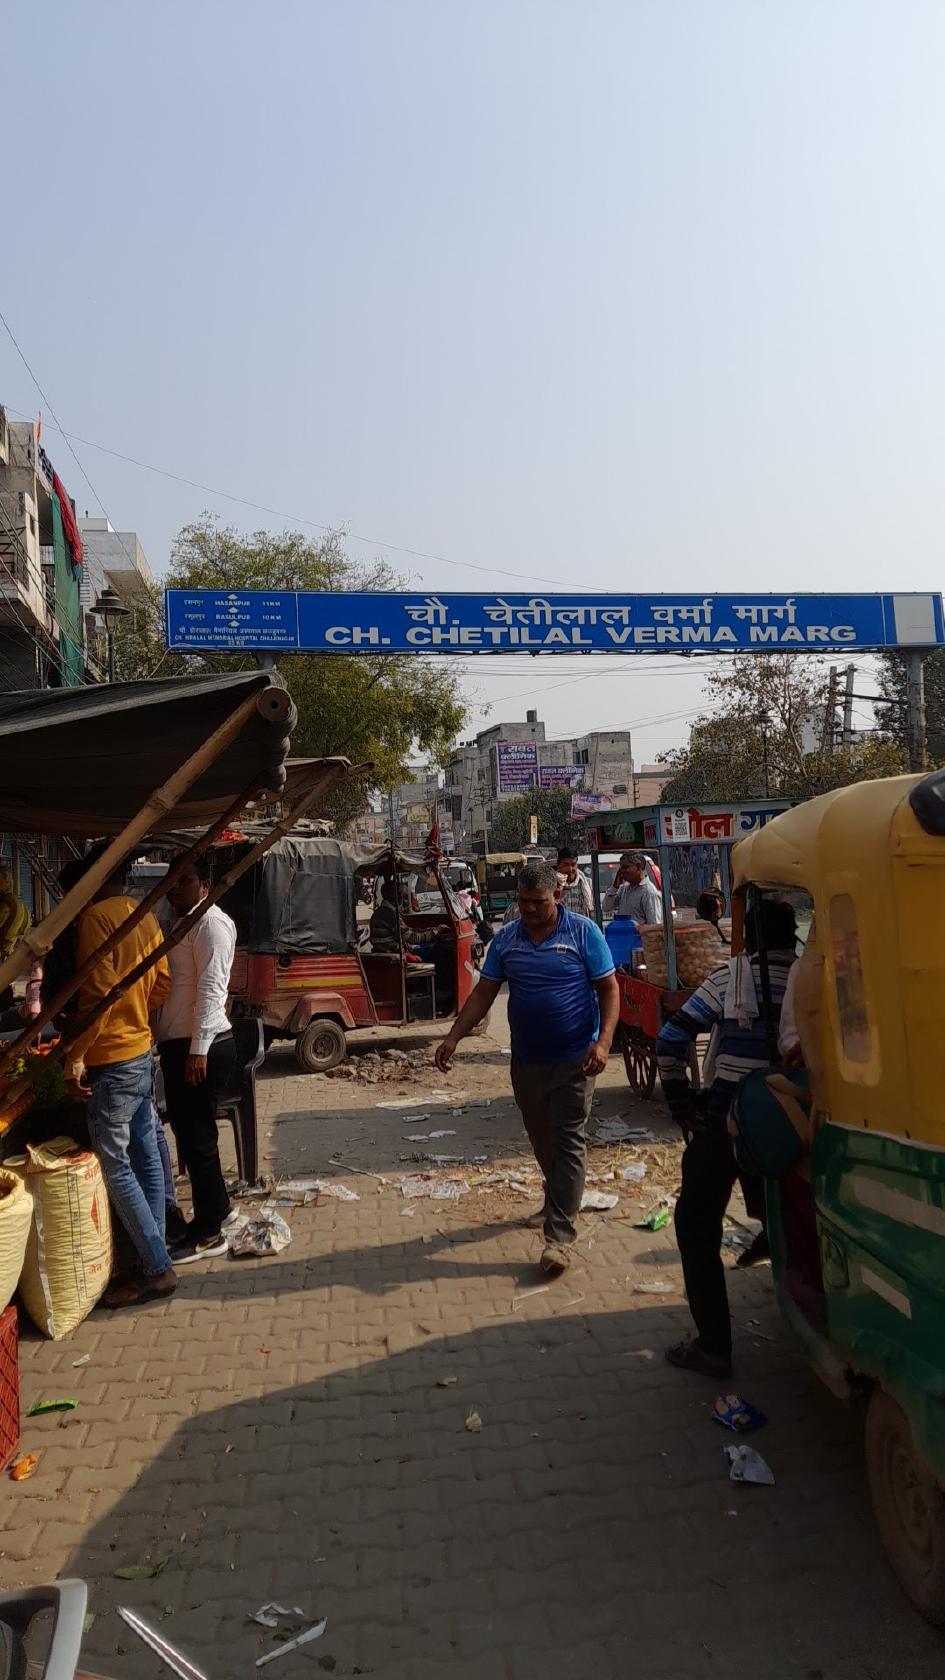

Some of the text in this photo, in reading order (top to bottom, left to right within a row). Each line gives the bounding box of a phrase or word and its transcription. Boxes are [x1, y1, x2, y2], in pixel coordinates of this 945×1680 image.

[404, 597, 797, 625] चौ. चेतीलाल वर्मा मार्ग
[325, 625, 857, 644] CH. CHETILAL VERMA MARG
